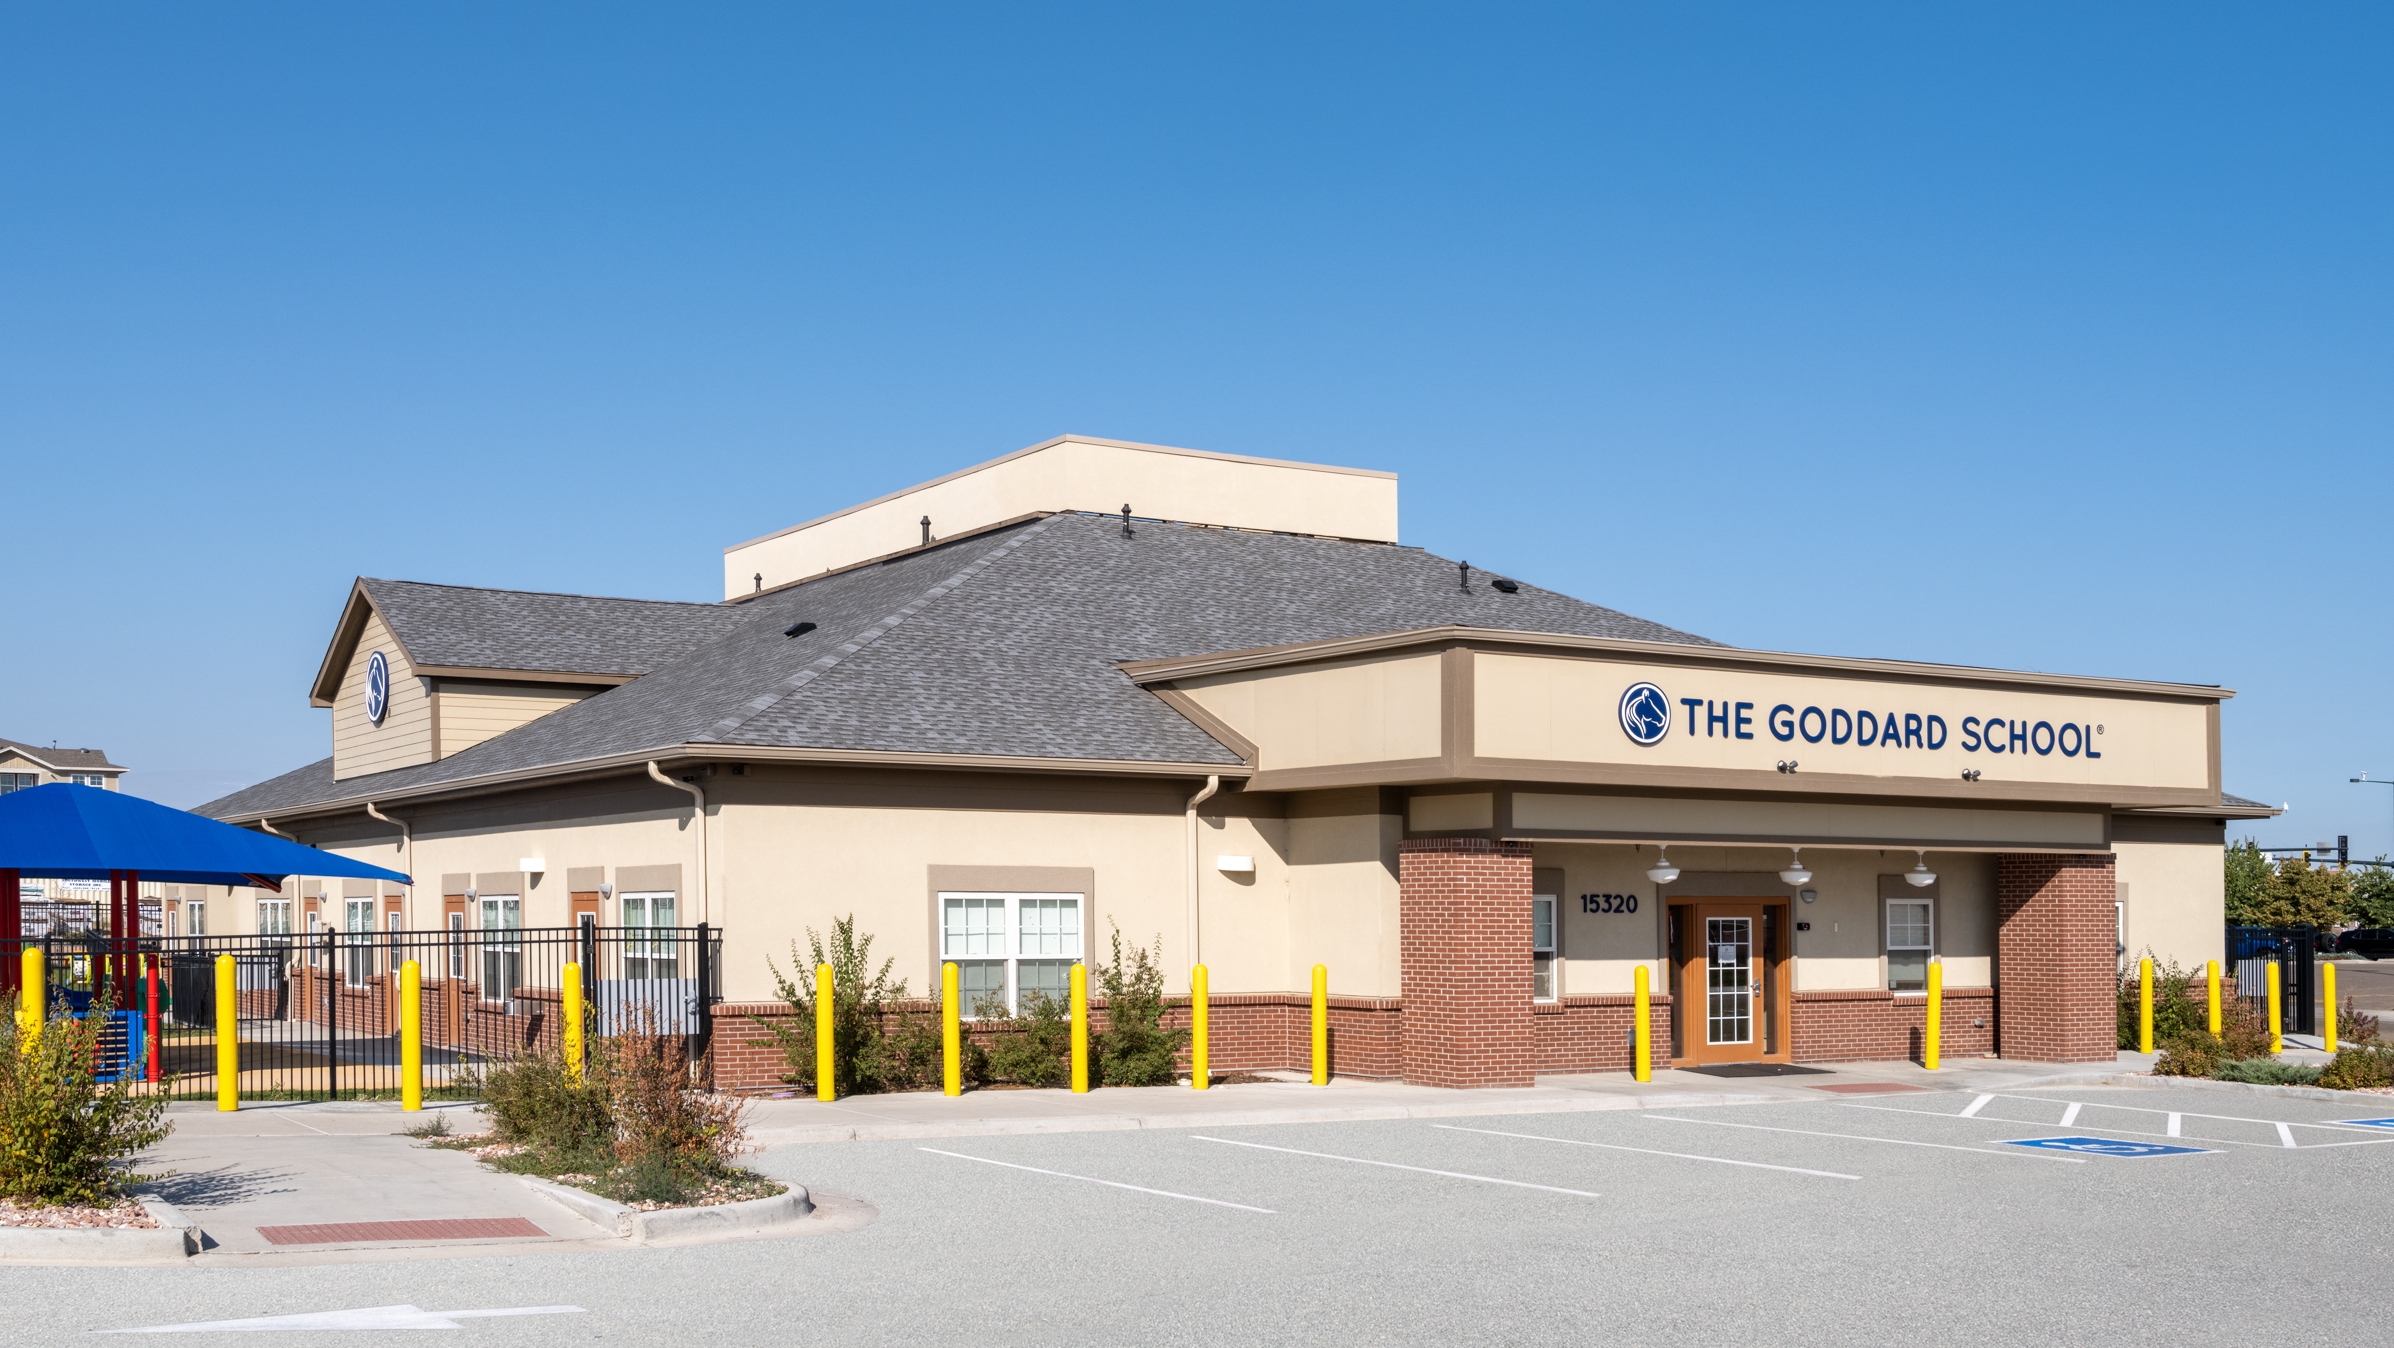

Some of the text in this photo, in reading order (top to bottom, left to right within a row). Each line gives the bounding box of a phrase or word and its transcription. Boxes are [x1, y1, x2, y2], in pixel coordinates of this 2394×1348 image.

[1679, 697, 1754, 740] THE
[1768, 703, 1948, 751] GODDARD
[1580, 893, 1639, 914] 15320
